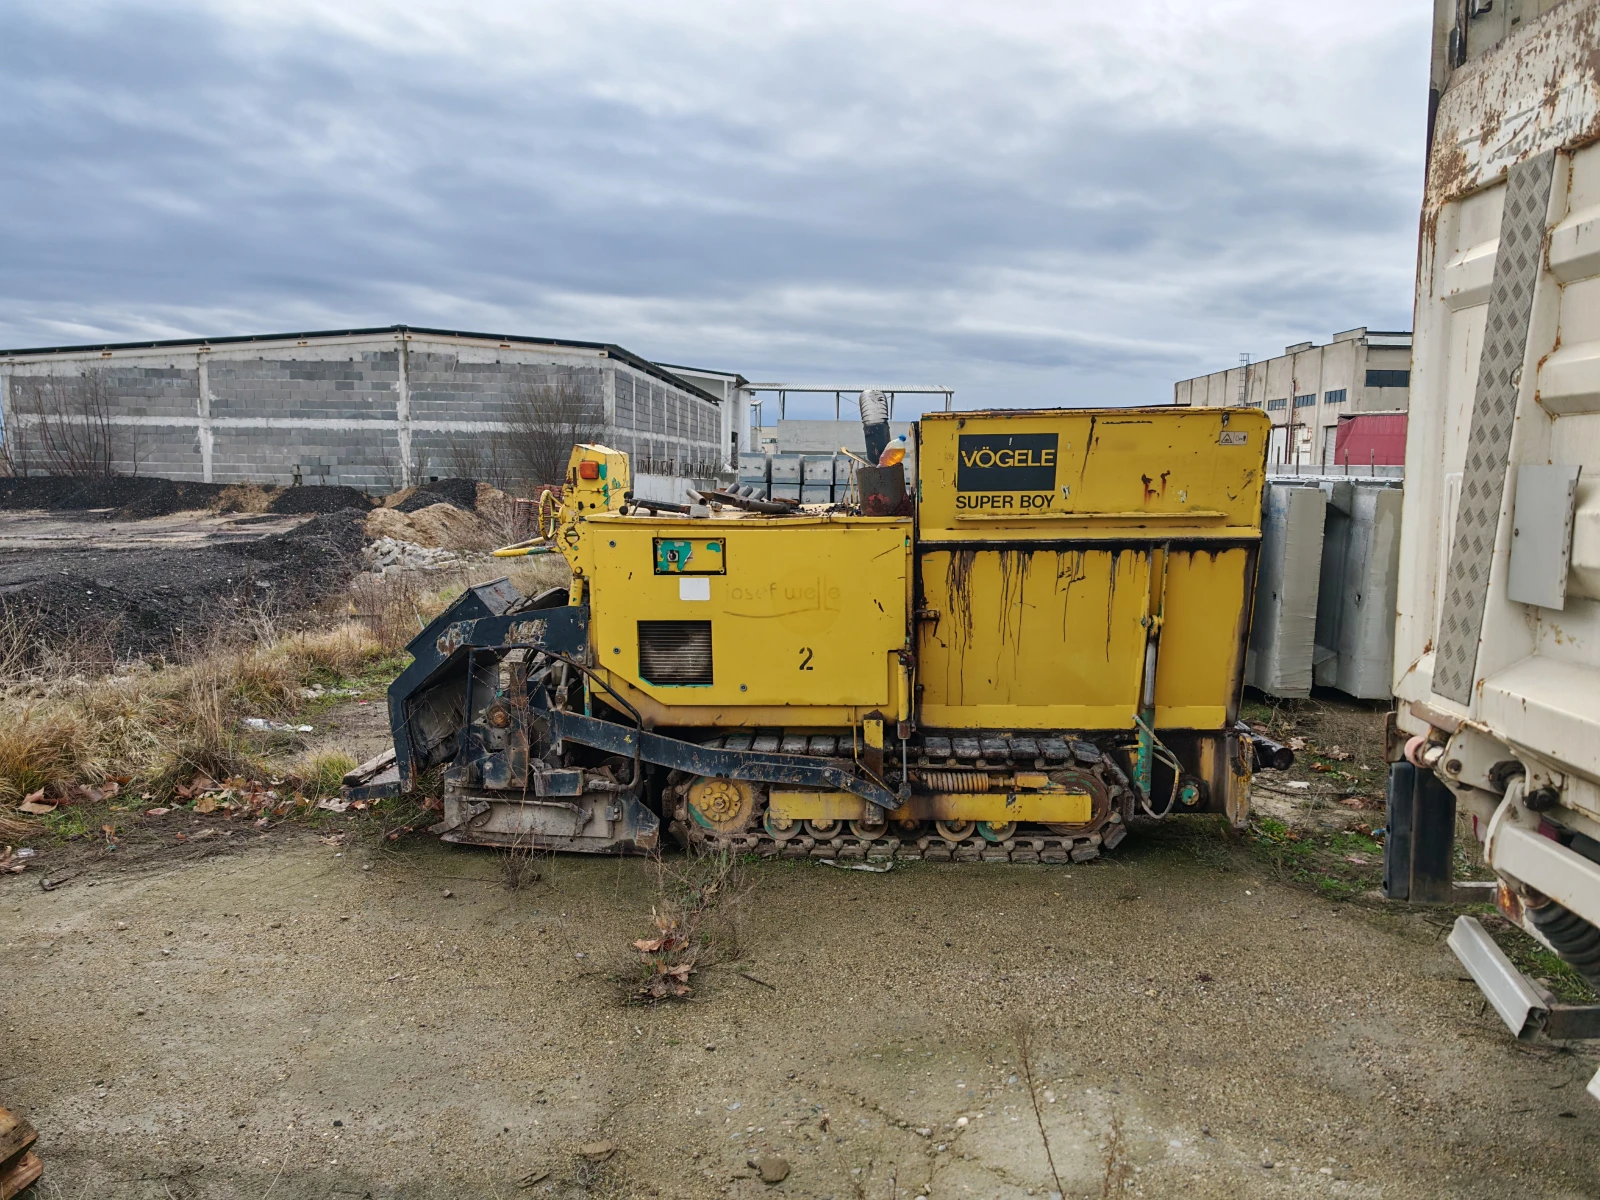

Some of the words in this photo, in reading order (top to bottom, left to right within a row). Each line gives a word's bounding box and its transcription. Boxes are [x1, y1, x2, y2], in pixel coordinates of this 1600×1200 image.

[961, 447, 1055, 467] VÖGELE
[956, 495, 1013, 509] SUPER
[1020, 494, 1055, 509] BOY
[799, 647, 814, 671] 2
